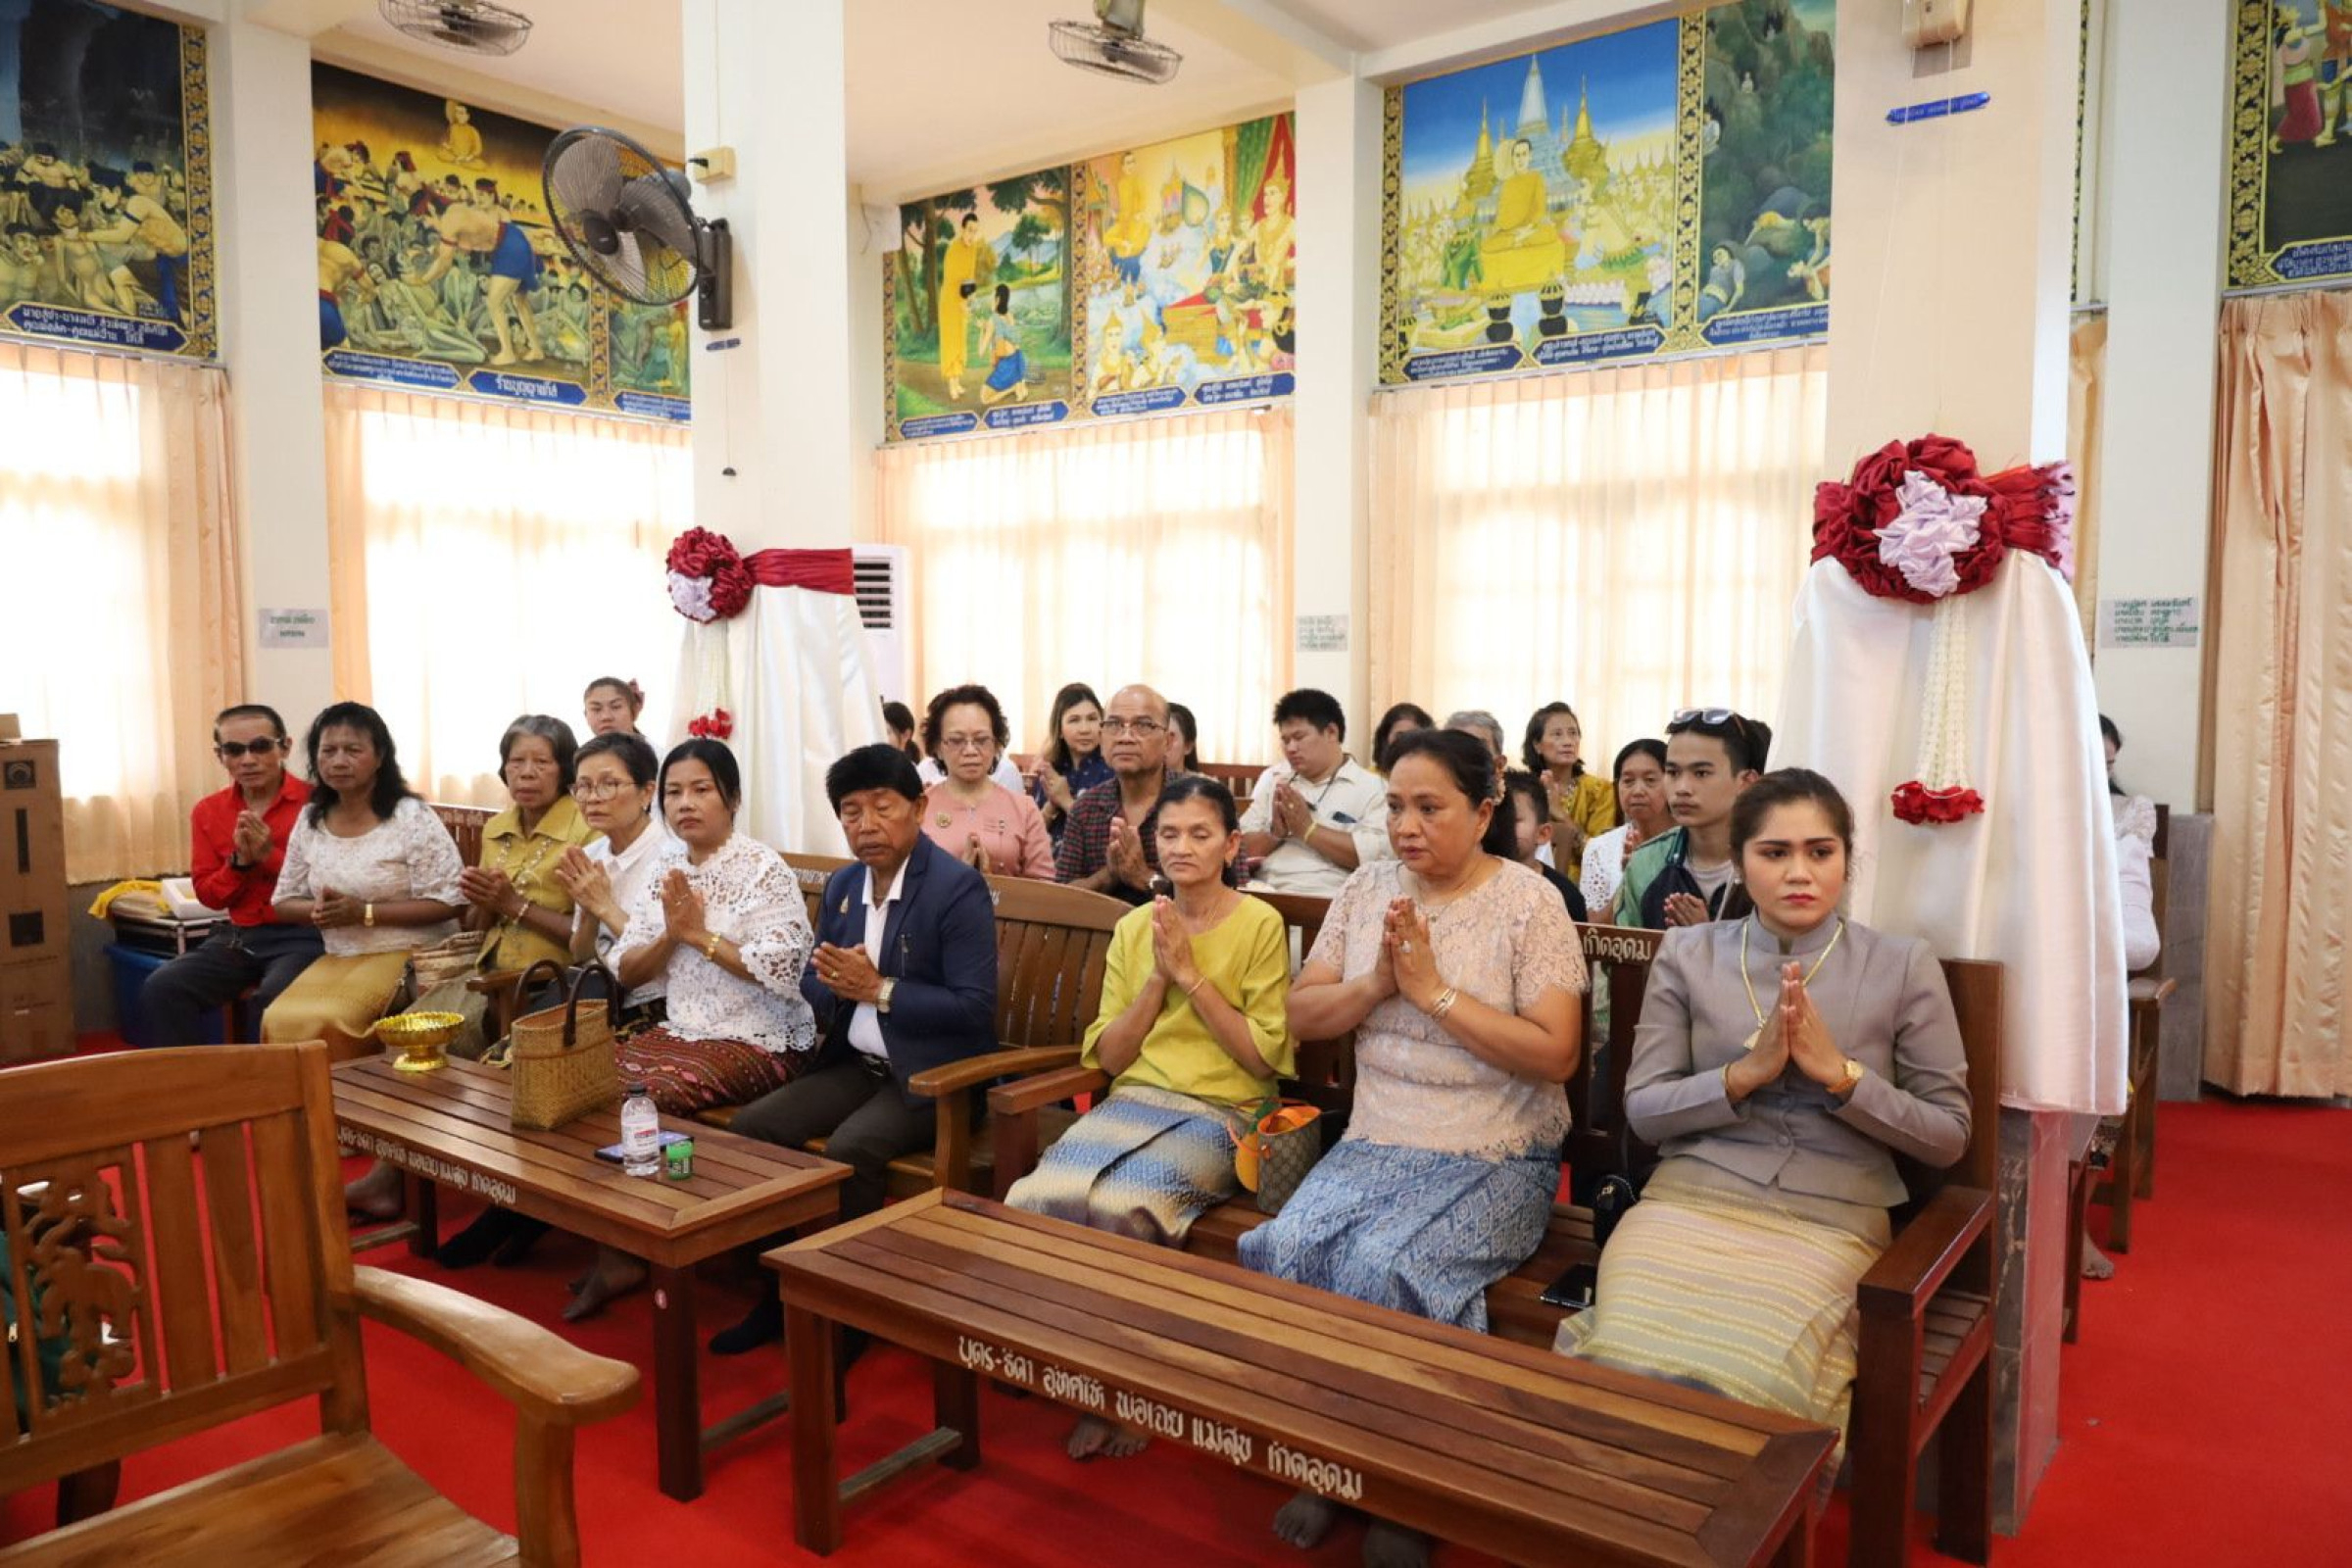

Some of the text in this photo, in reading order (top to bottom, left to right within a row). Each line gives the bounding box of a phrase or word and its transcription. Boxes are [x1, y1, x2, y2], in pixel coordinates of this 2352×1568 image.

[1583, 927, 1651, 963] เกิดอุดม
[958, 1335, 1034, 1385] บุตร-ธิดา
[1043, 1363, 1105, 1411] อุทิศให้
[1192, 1417, 1252, 1466] แม่สุข
[1267, 1441, 1363, 1501] เกิดอุดม
